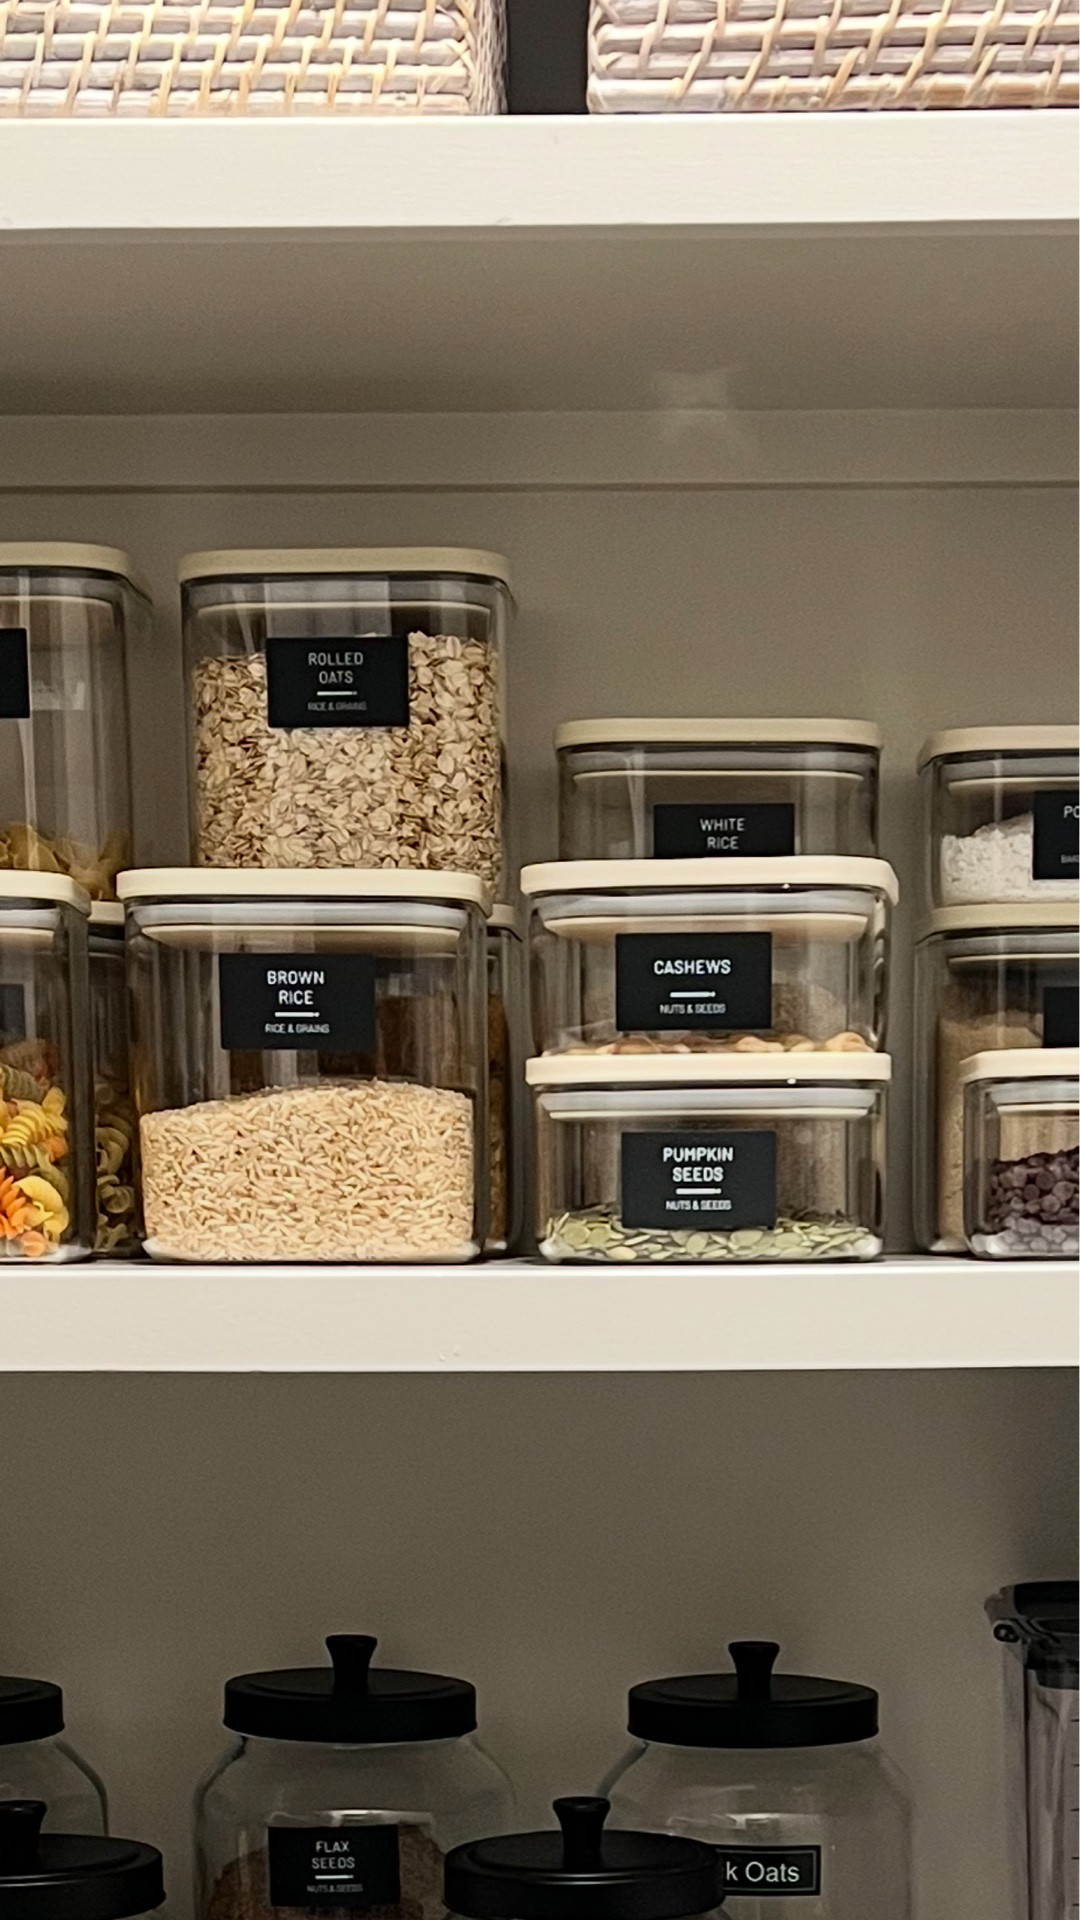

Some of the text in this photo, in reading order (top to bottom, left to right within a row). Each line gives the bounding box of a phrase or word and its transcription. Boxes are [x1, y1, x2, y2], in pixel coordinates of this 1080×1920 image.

[308, 651, 364, 666] ROLLED
[318, 670, 354, 685] OATS
[699, 817, 745, 832] WHITE
[706, 835, 739, 850] RICE
[653, 959, 732, 975] CASHEWS
[267, 970, 325, 985] BROWN
[278, 989, 314, 1005] RICE
[265, 1023, 330, 1034] RICE & GRAINS
[662, 1146, 734, 1162] PUMPKIN
[672, 1166, 724, 1182] SEEDS
[315, 1840, 350, 1853] FLAX
[311, 1856, 356, 1869] SEEDS
[745, 1861, 800, 1882] Oats
